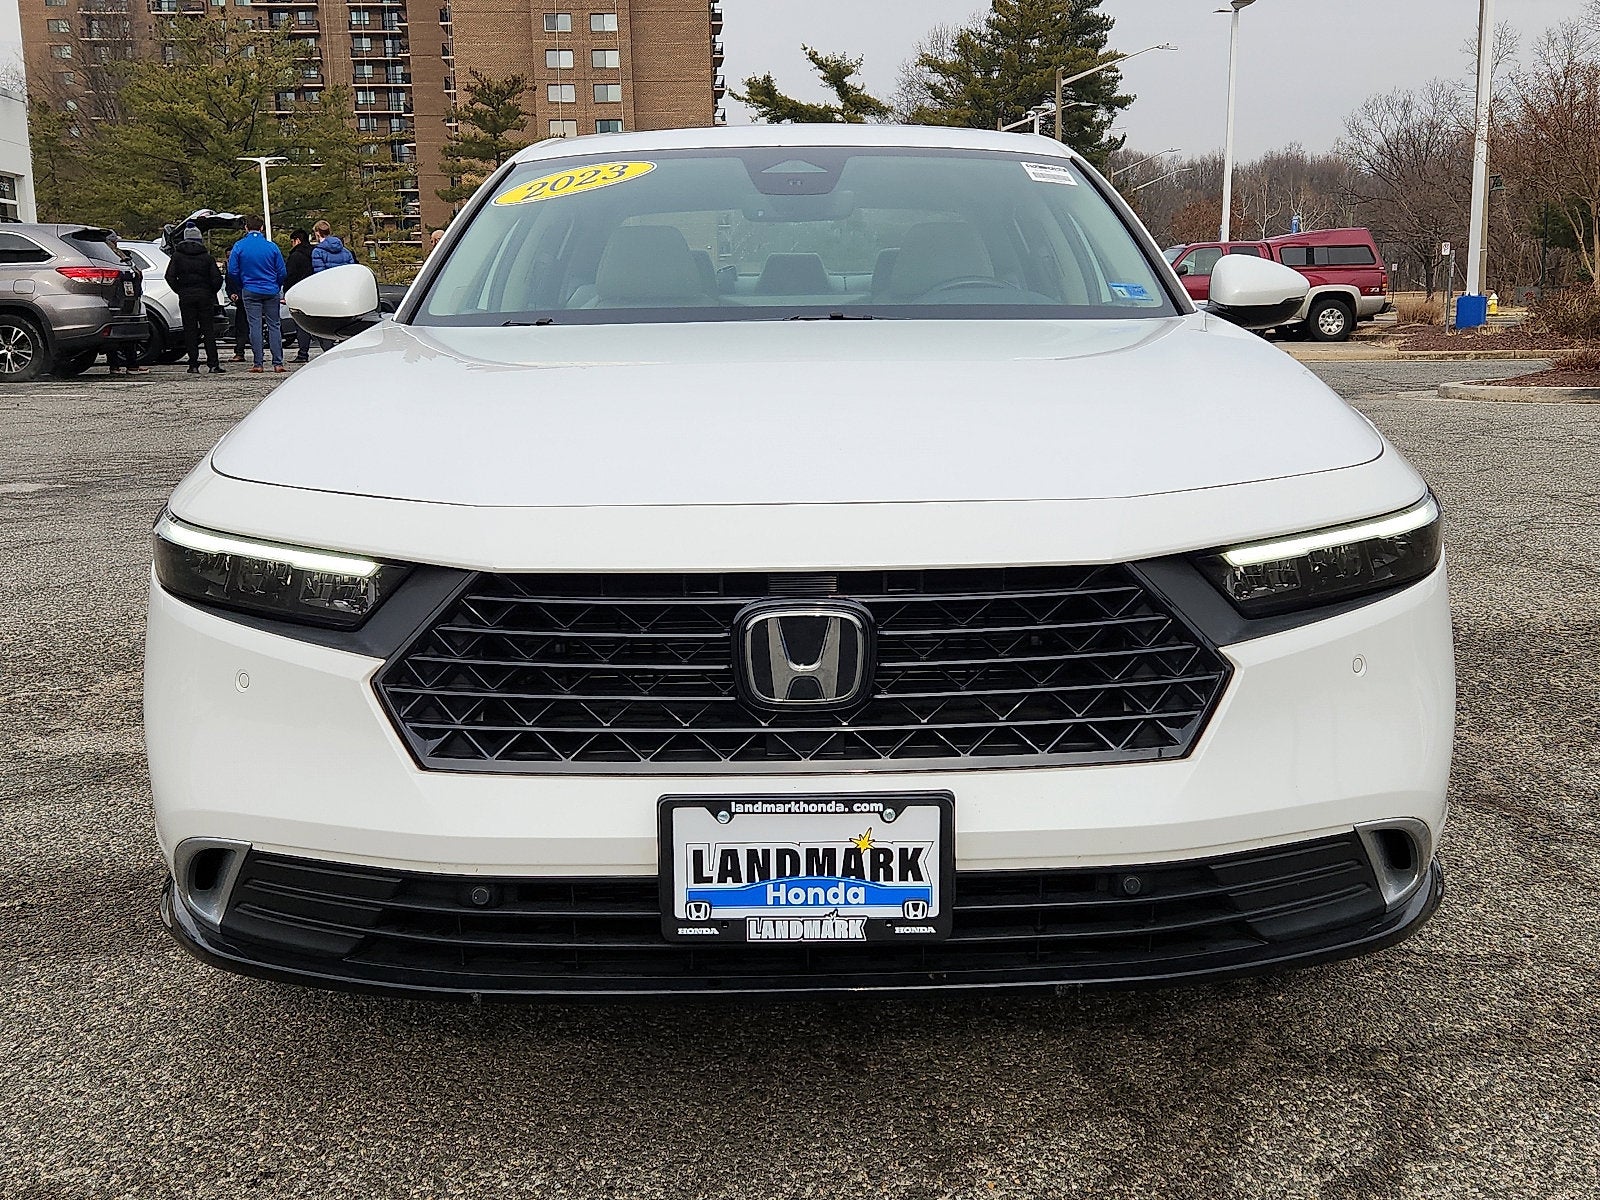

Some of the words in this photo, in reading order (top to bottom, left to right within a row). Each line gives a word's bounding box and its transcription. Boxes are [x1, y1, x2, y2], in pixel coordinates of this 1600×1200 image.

[520, 164, 630, 200] 2023
[731, 802, 849, 813] landmarkhonda.
[853, 802, 884, 812] com
[693, 847, 923, 884] LANDMARK
[766, 882, 866, 905] Honda
[678, 927, 719, 935] HONDA
[749, 920, 863, 939] LANDMARK
